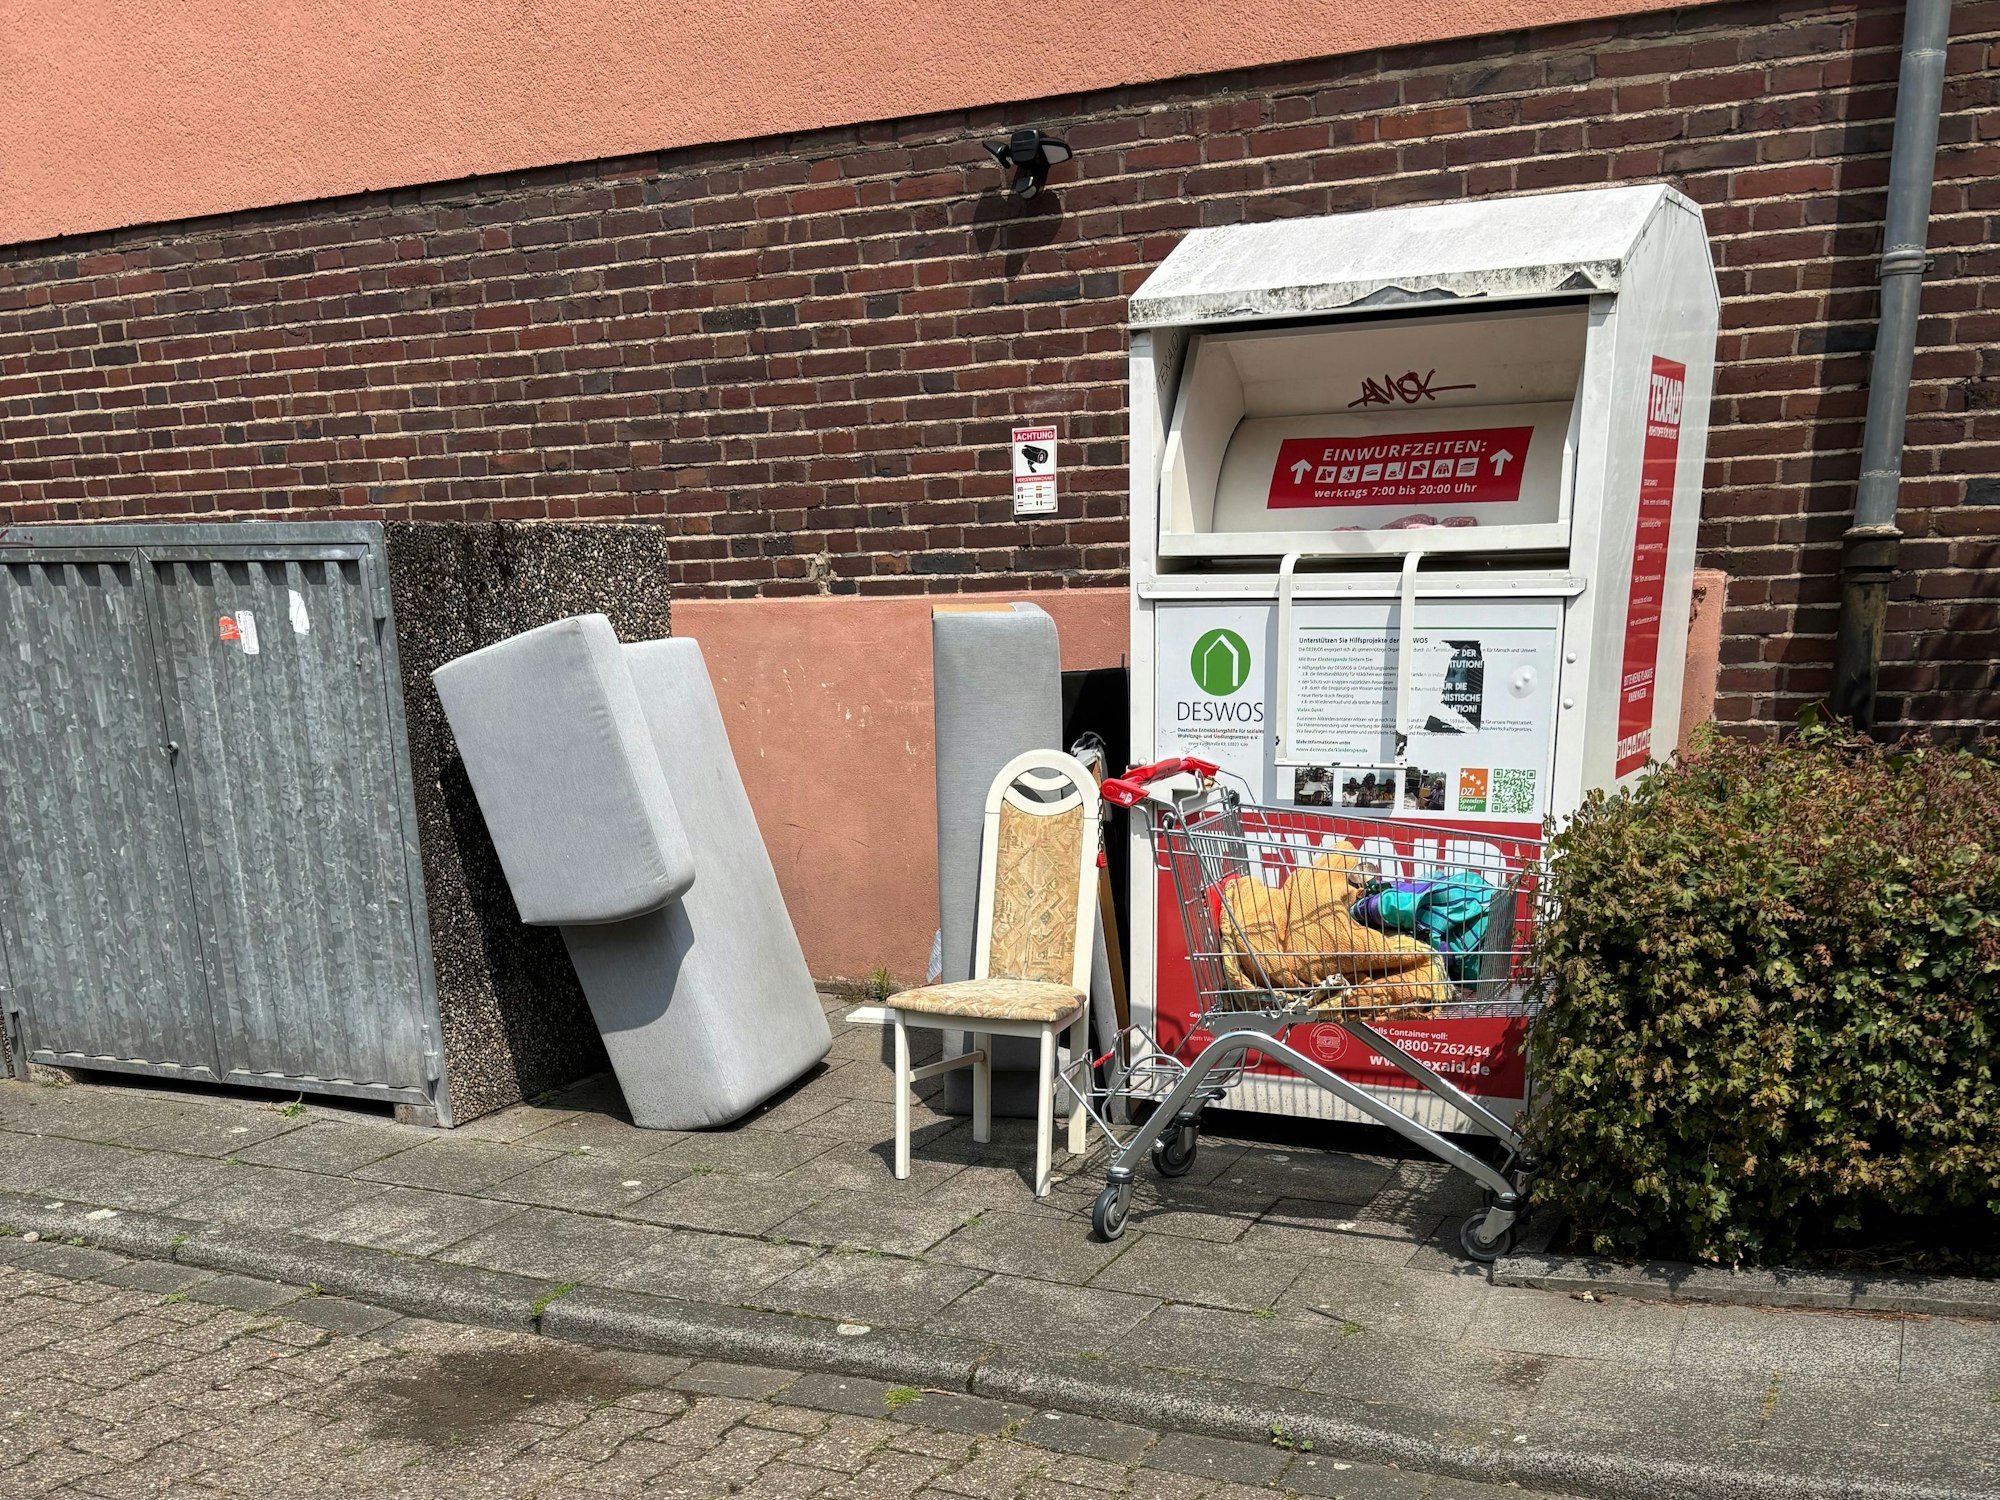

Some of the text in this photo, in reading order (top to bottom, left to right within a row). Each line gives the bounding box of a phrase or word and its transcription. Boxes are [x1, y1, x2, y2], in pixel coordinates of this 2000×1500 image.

[1650, 373, 1683, 425] TEXAID
[1016, 431, 1054, 441] ACHTUNG
[1322, 439, 1488, 462] EINWURFZEITEN:
[1314, 483, 1478, 499] werktags 7:00 bis 20:00 Uhr
[1350, 637, 1387, 645] Hilfsprojekte
[1461, 649, 1477, 658] DER
[1455, 682, 1467, 691] DIE
[1441, 693, 1480, 702] NISTISCHE
[1177, 701, 1264, 722] DESWOS
[1460, 787, 1476, 796] DZI
[1460, 803, 1477, 811] Siegel
[1371, 1026, 1448, 1040] alls Container voll:
[1396, 1039, 1490, 1057] 0800-7262454
